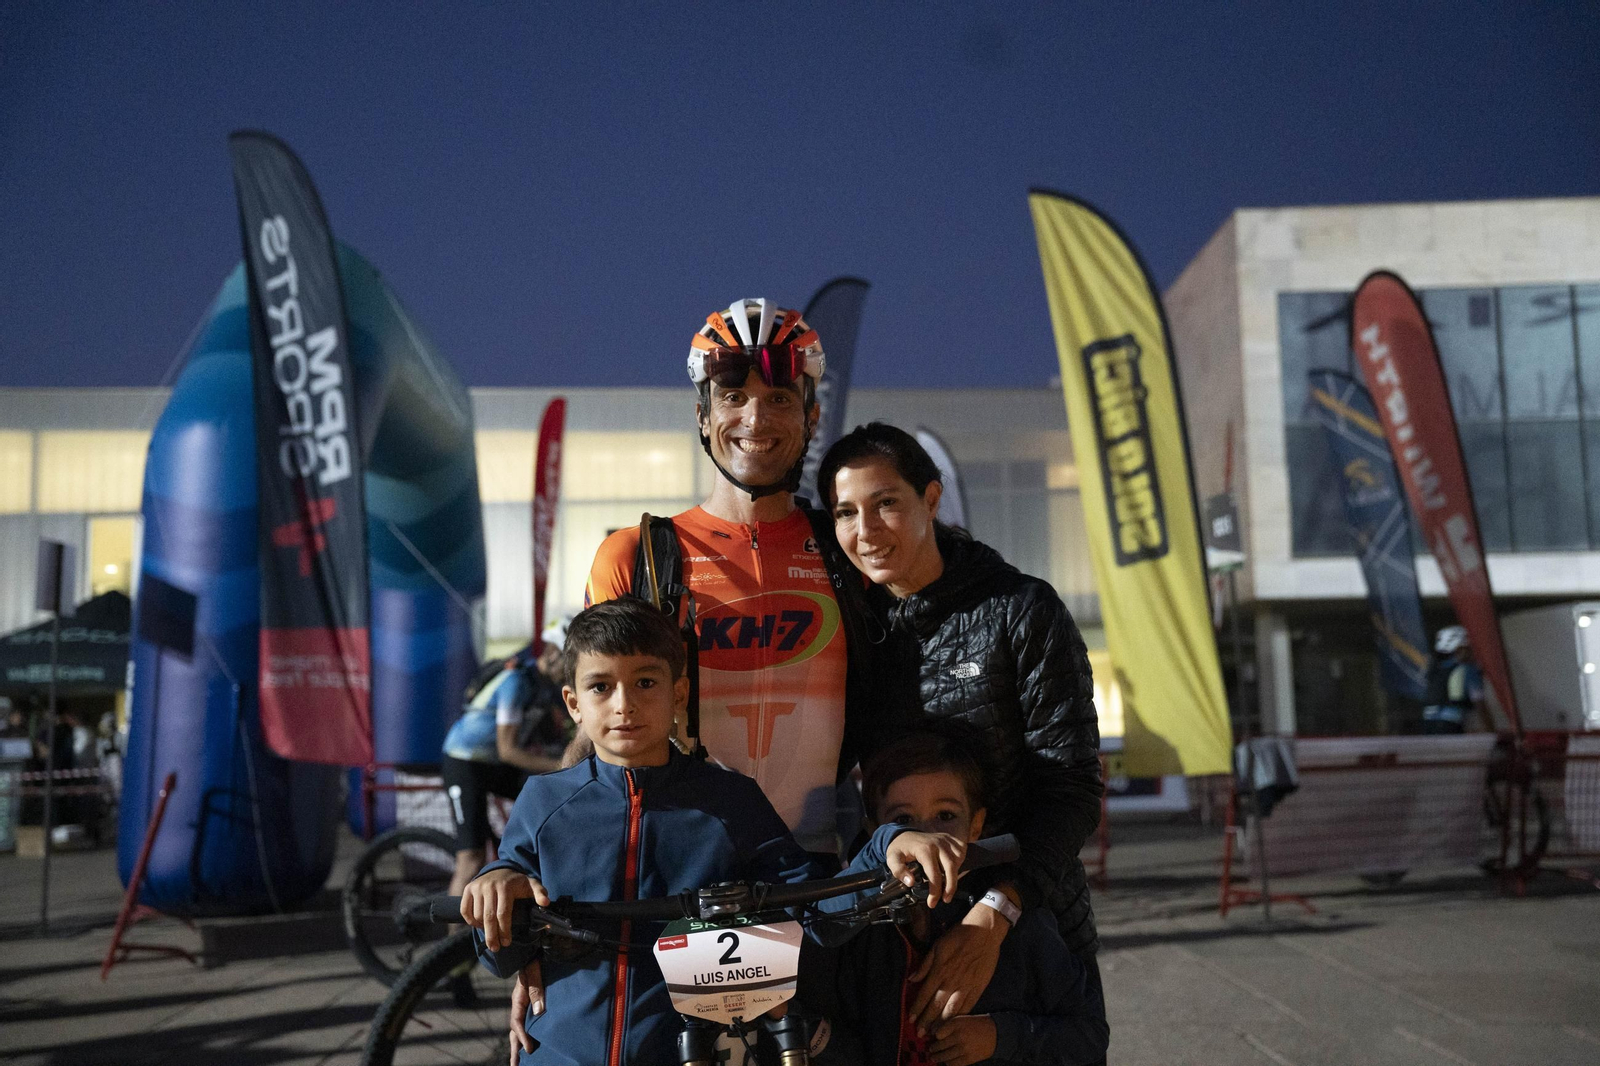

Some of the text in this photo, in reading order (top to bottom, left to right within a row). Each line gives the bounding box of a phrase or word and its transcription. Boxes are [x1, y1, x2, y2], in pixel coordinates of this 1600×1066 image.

[717, 931, 742, 966] 2
[693, 965, 772, 986] LUIS ANGEL
